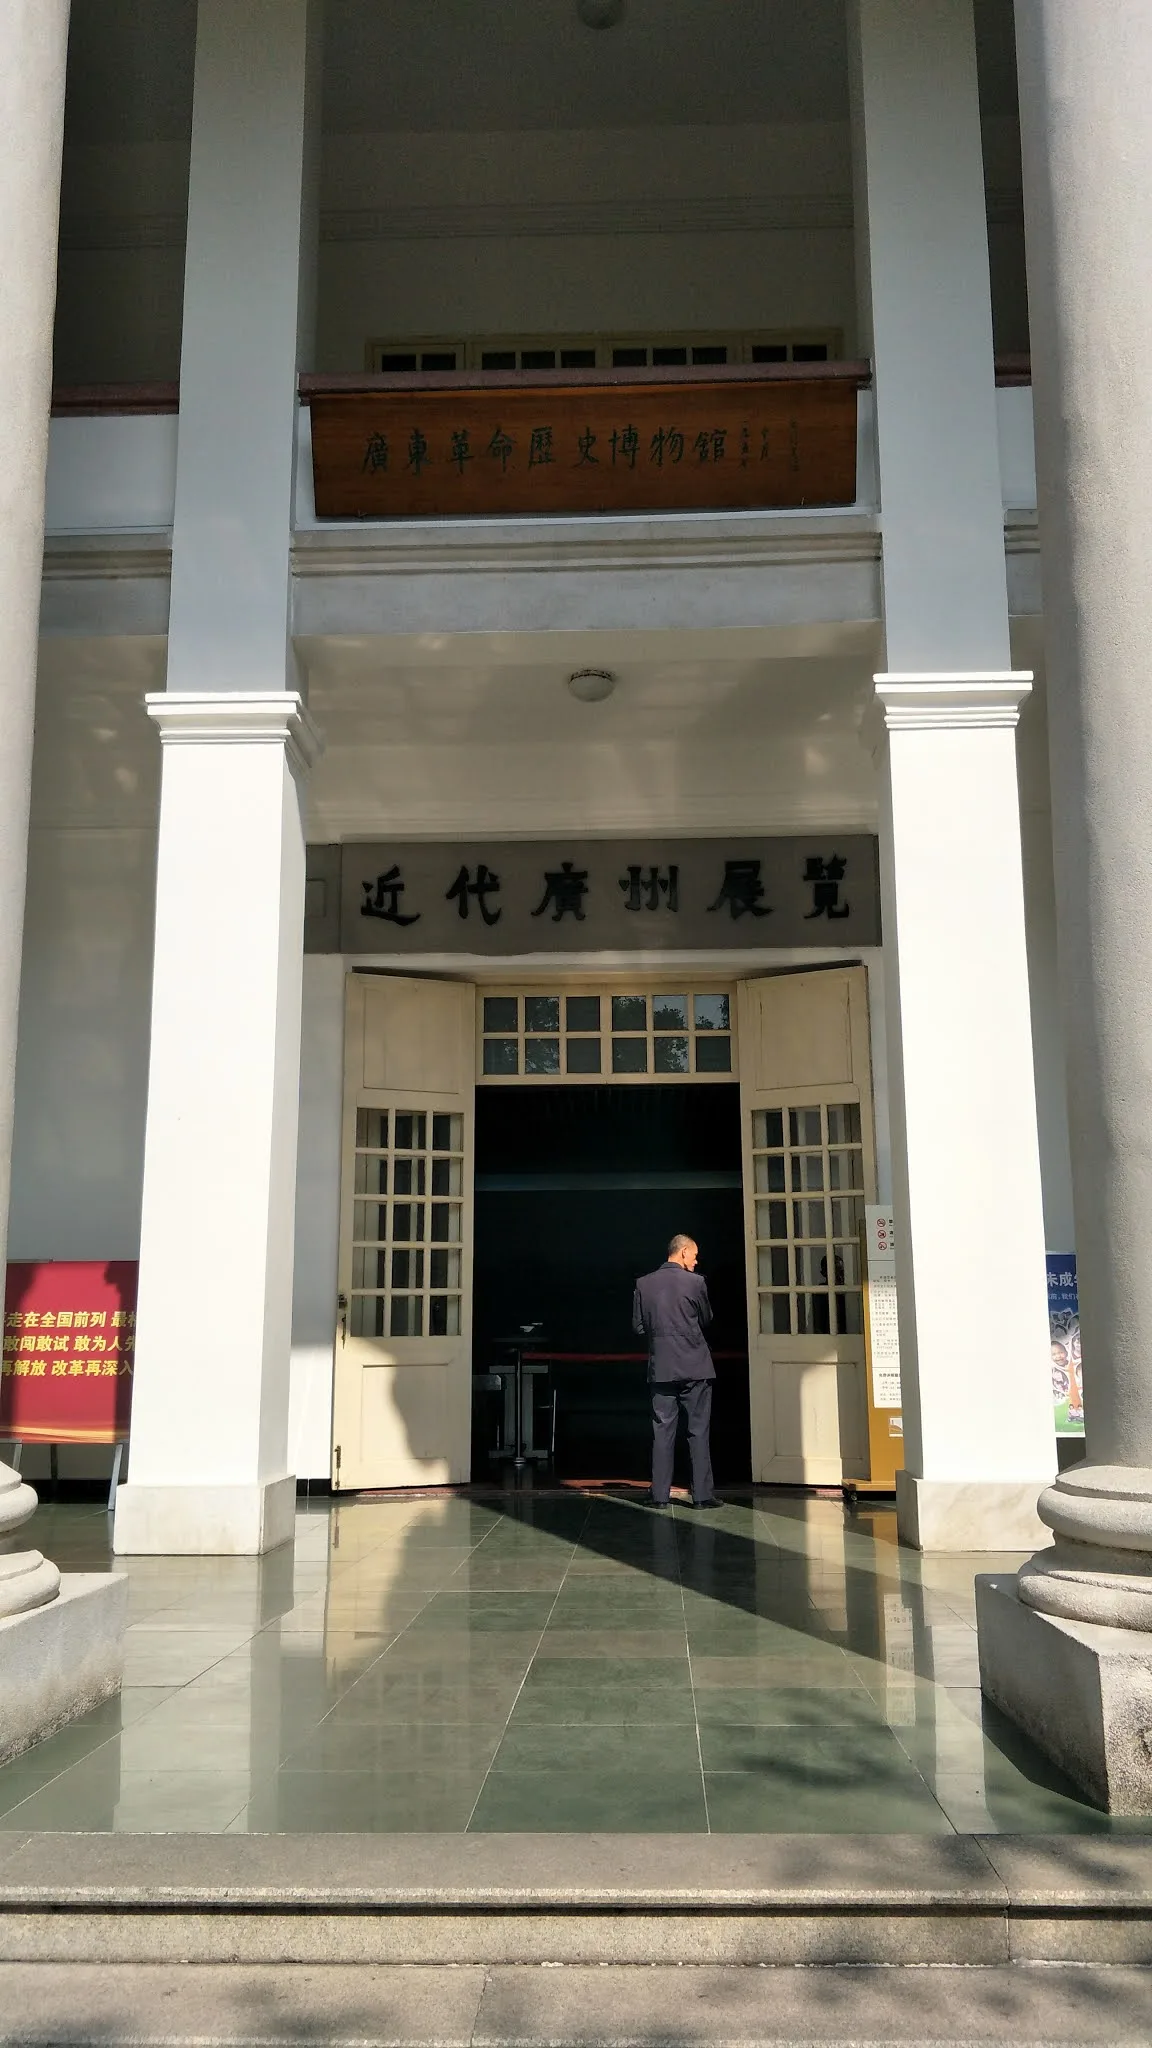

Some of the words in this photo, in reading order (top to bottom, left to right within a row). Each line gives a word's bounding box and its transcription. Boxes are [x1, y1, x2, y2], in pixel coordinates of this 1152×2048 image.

[1047, 1272, 1078, 1287] 未成
[4, 1311, 107, 1328] 走在全国前列
[3, 1335, 70, 1352] 敢闯敢试
[51, 1359, 134, 1377] 改革再深入
